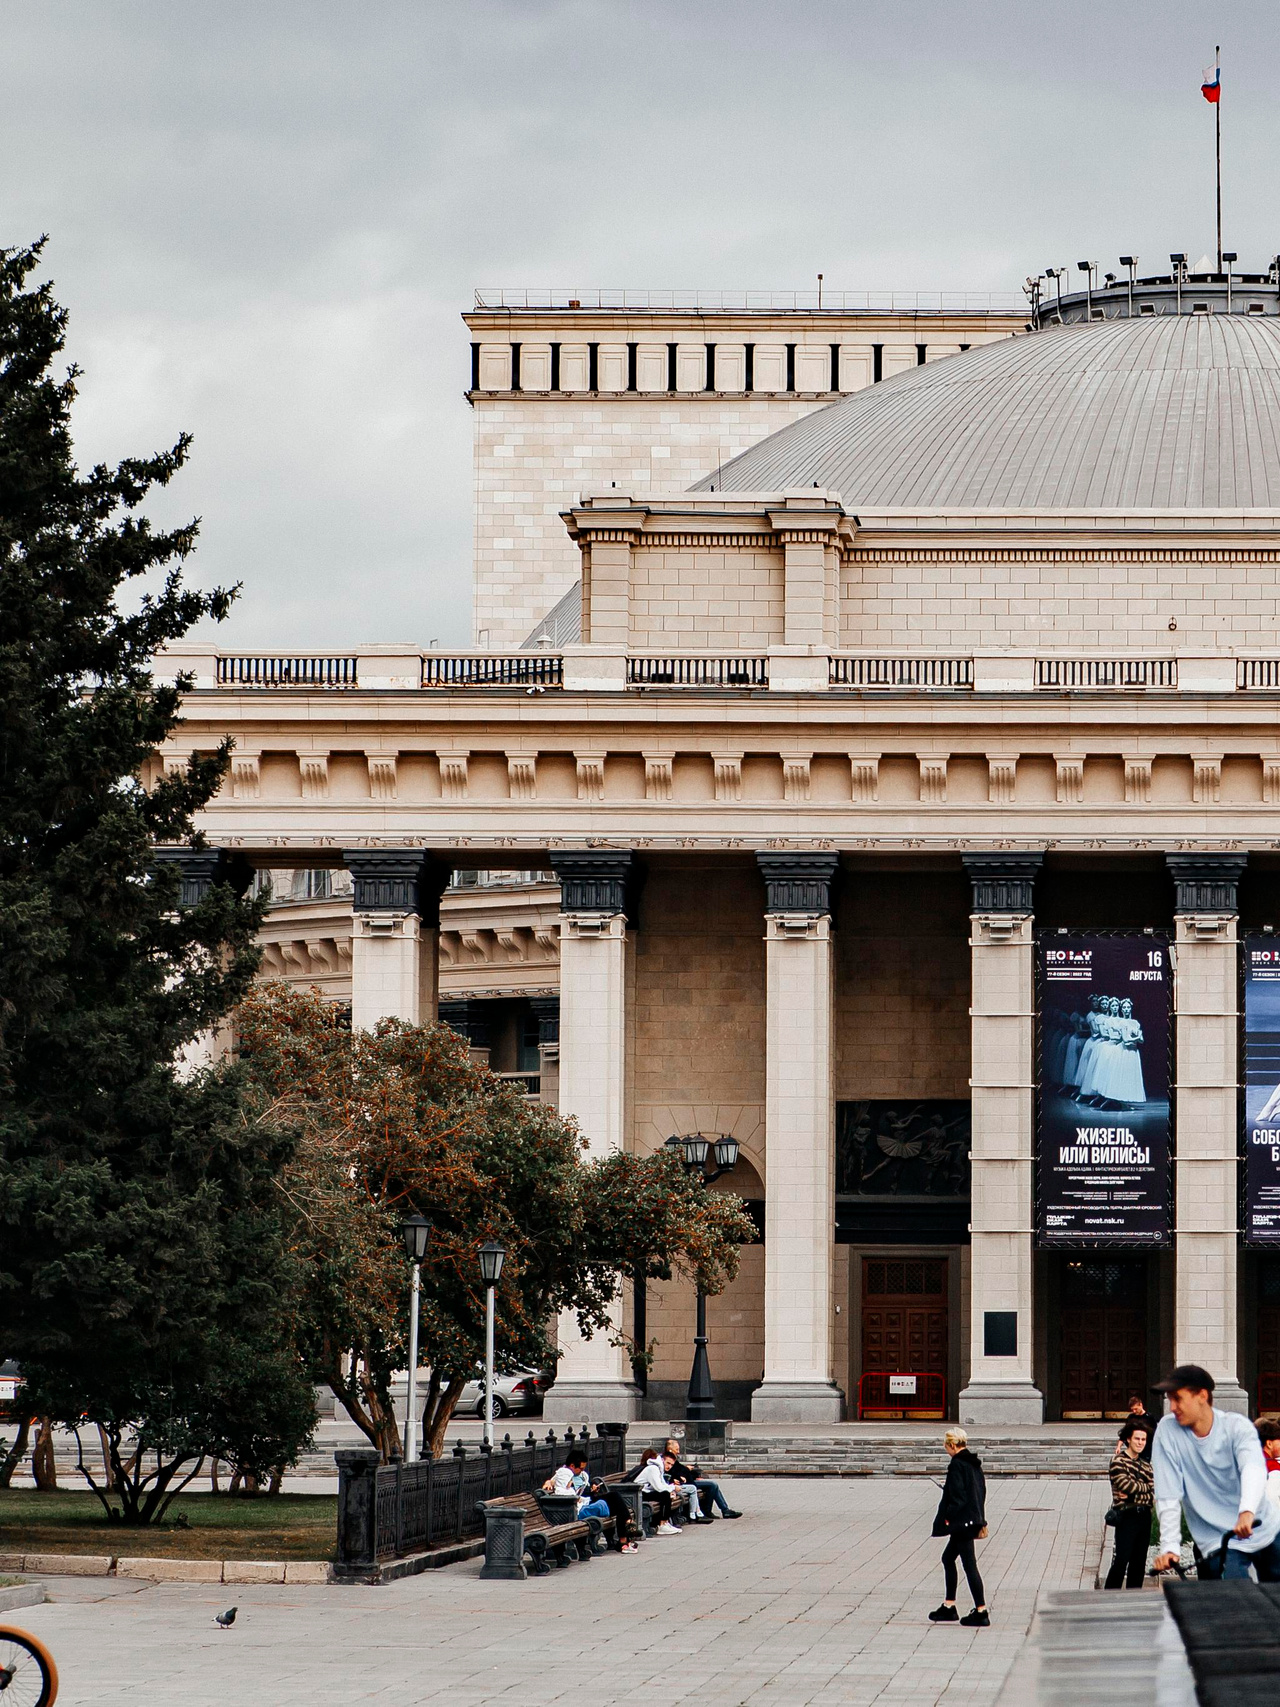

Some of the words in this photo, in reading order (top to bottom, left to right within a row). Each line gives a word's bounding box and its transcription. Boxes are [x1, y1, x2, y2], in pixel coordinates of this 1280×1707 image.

[1147, 951, 1162, 967] 16
[1130, 971, 1162, 981] АВГУСТА
[1076, 1128, 1138, 1147] ЖИЗЕЛЬ,
[1060, 1147, 1089, 1164] ИЛИ
[1091, 1147, 1150, 1164] ВИЛИСЫ
